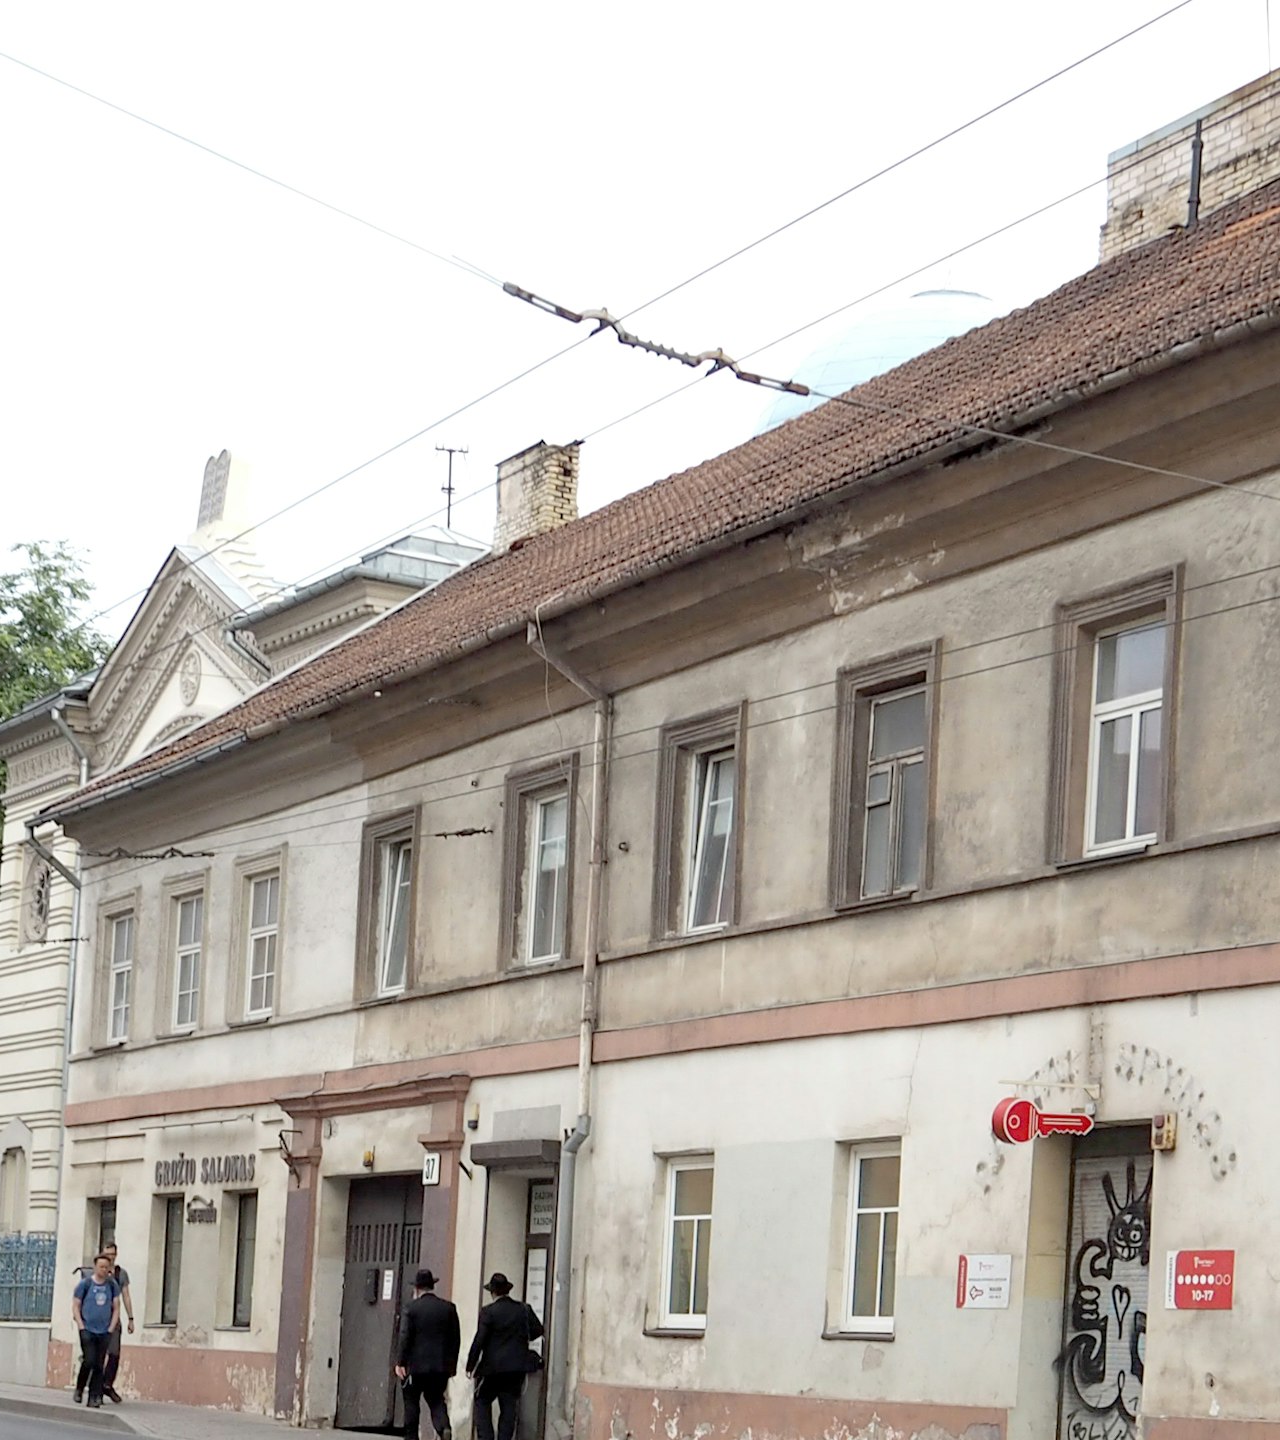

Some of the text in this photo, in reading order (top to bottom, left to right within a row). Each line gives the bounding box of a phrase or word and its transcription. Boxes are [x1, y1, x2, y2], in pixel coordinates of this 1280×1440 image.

[155, 1152, 256, 1187] GROŽIO SALONAS
[425, 1158, 435, 1180] 37
[1191, 1289, 1214, 1301] 10-17
